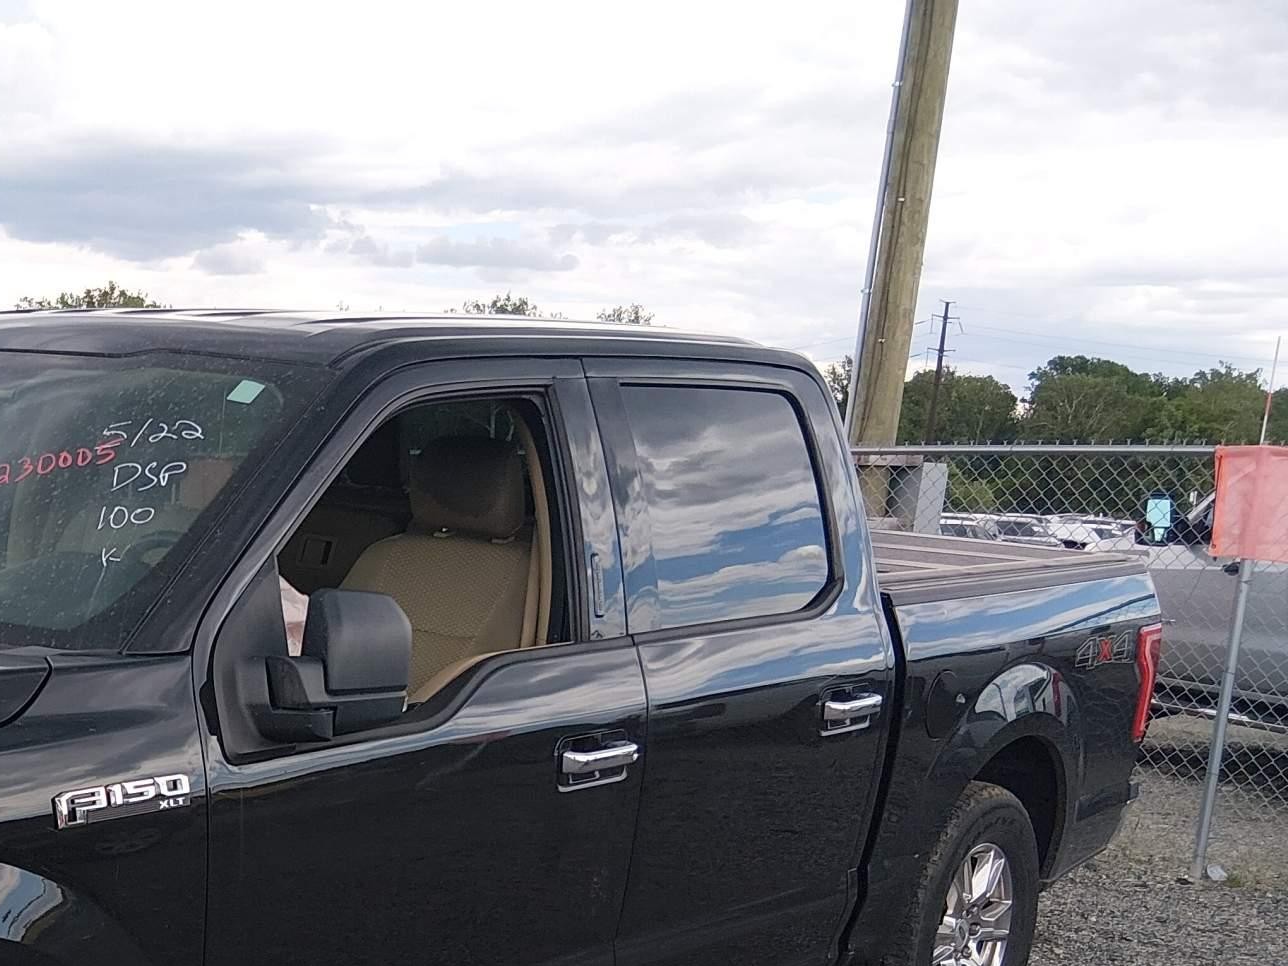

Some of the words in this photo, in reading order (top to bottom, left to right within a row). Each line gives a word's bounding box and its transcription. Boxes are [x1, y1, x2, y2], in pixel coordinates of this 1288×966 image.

[99, 417, 205, 448] 5/22
[110, 461, 188, 493] DSP
[96, 505, 155, 531] 100
[159, 796, 186, 810] XLT
